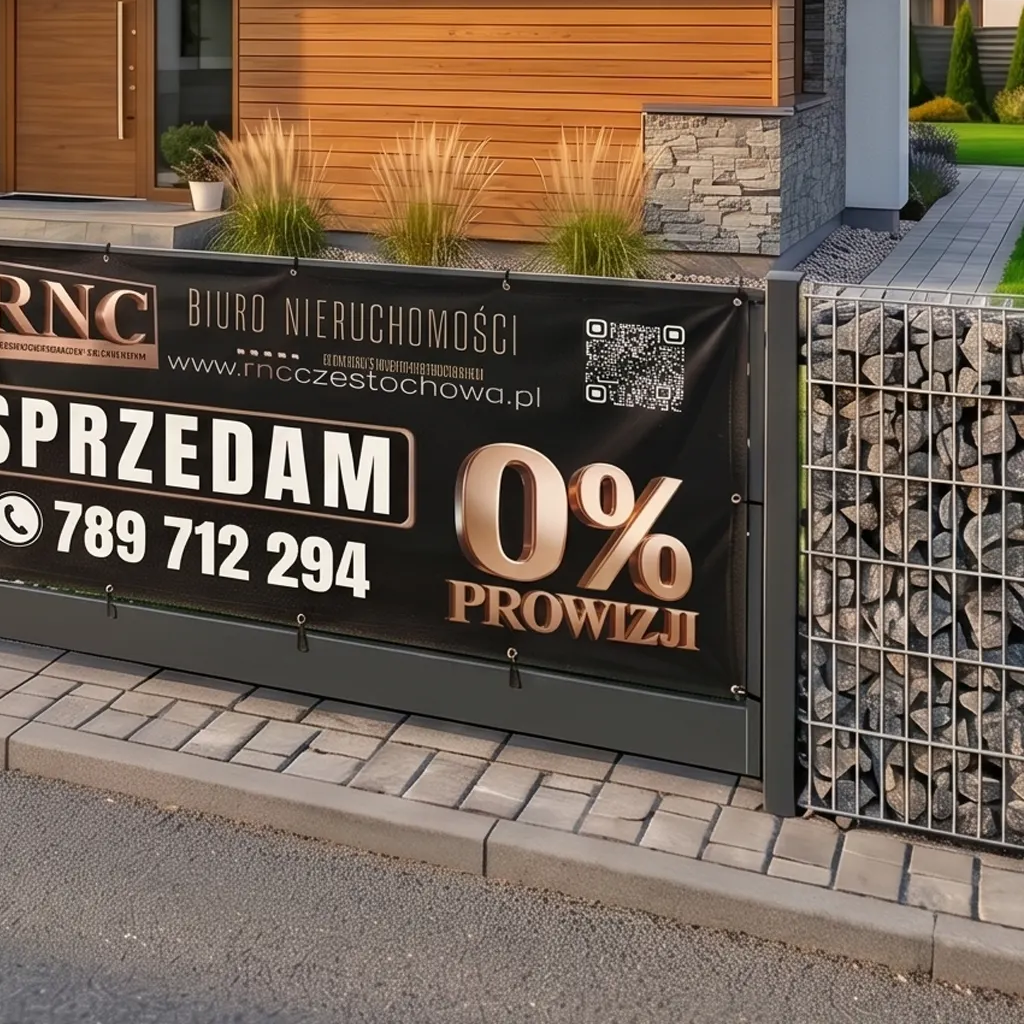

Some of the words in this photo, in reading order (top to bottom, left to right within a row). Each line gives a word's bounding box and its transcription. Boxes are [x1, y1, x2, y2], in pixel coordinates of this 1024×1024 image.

[189, 288, 265, 333] BIURO
[285, 296, 517, 356] NIERUCHOMOŚCI
[167, 355, 541, 411] www.rncczestochowa.pl
[53, 501, 146, 563] 789
[163, 516, 250, 581] 712
[266, 532, 370, 599] 294
[454, 442, 693, 602] 0%
[445, 579, 700, 651] PROWIZJI
